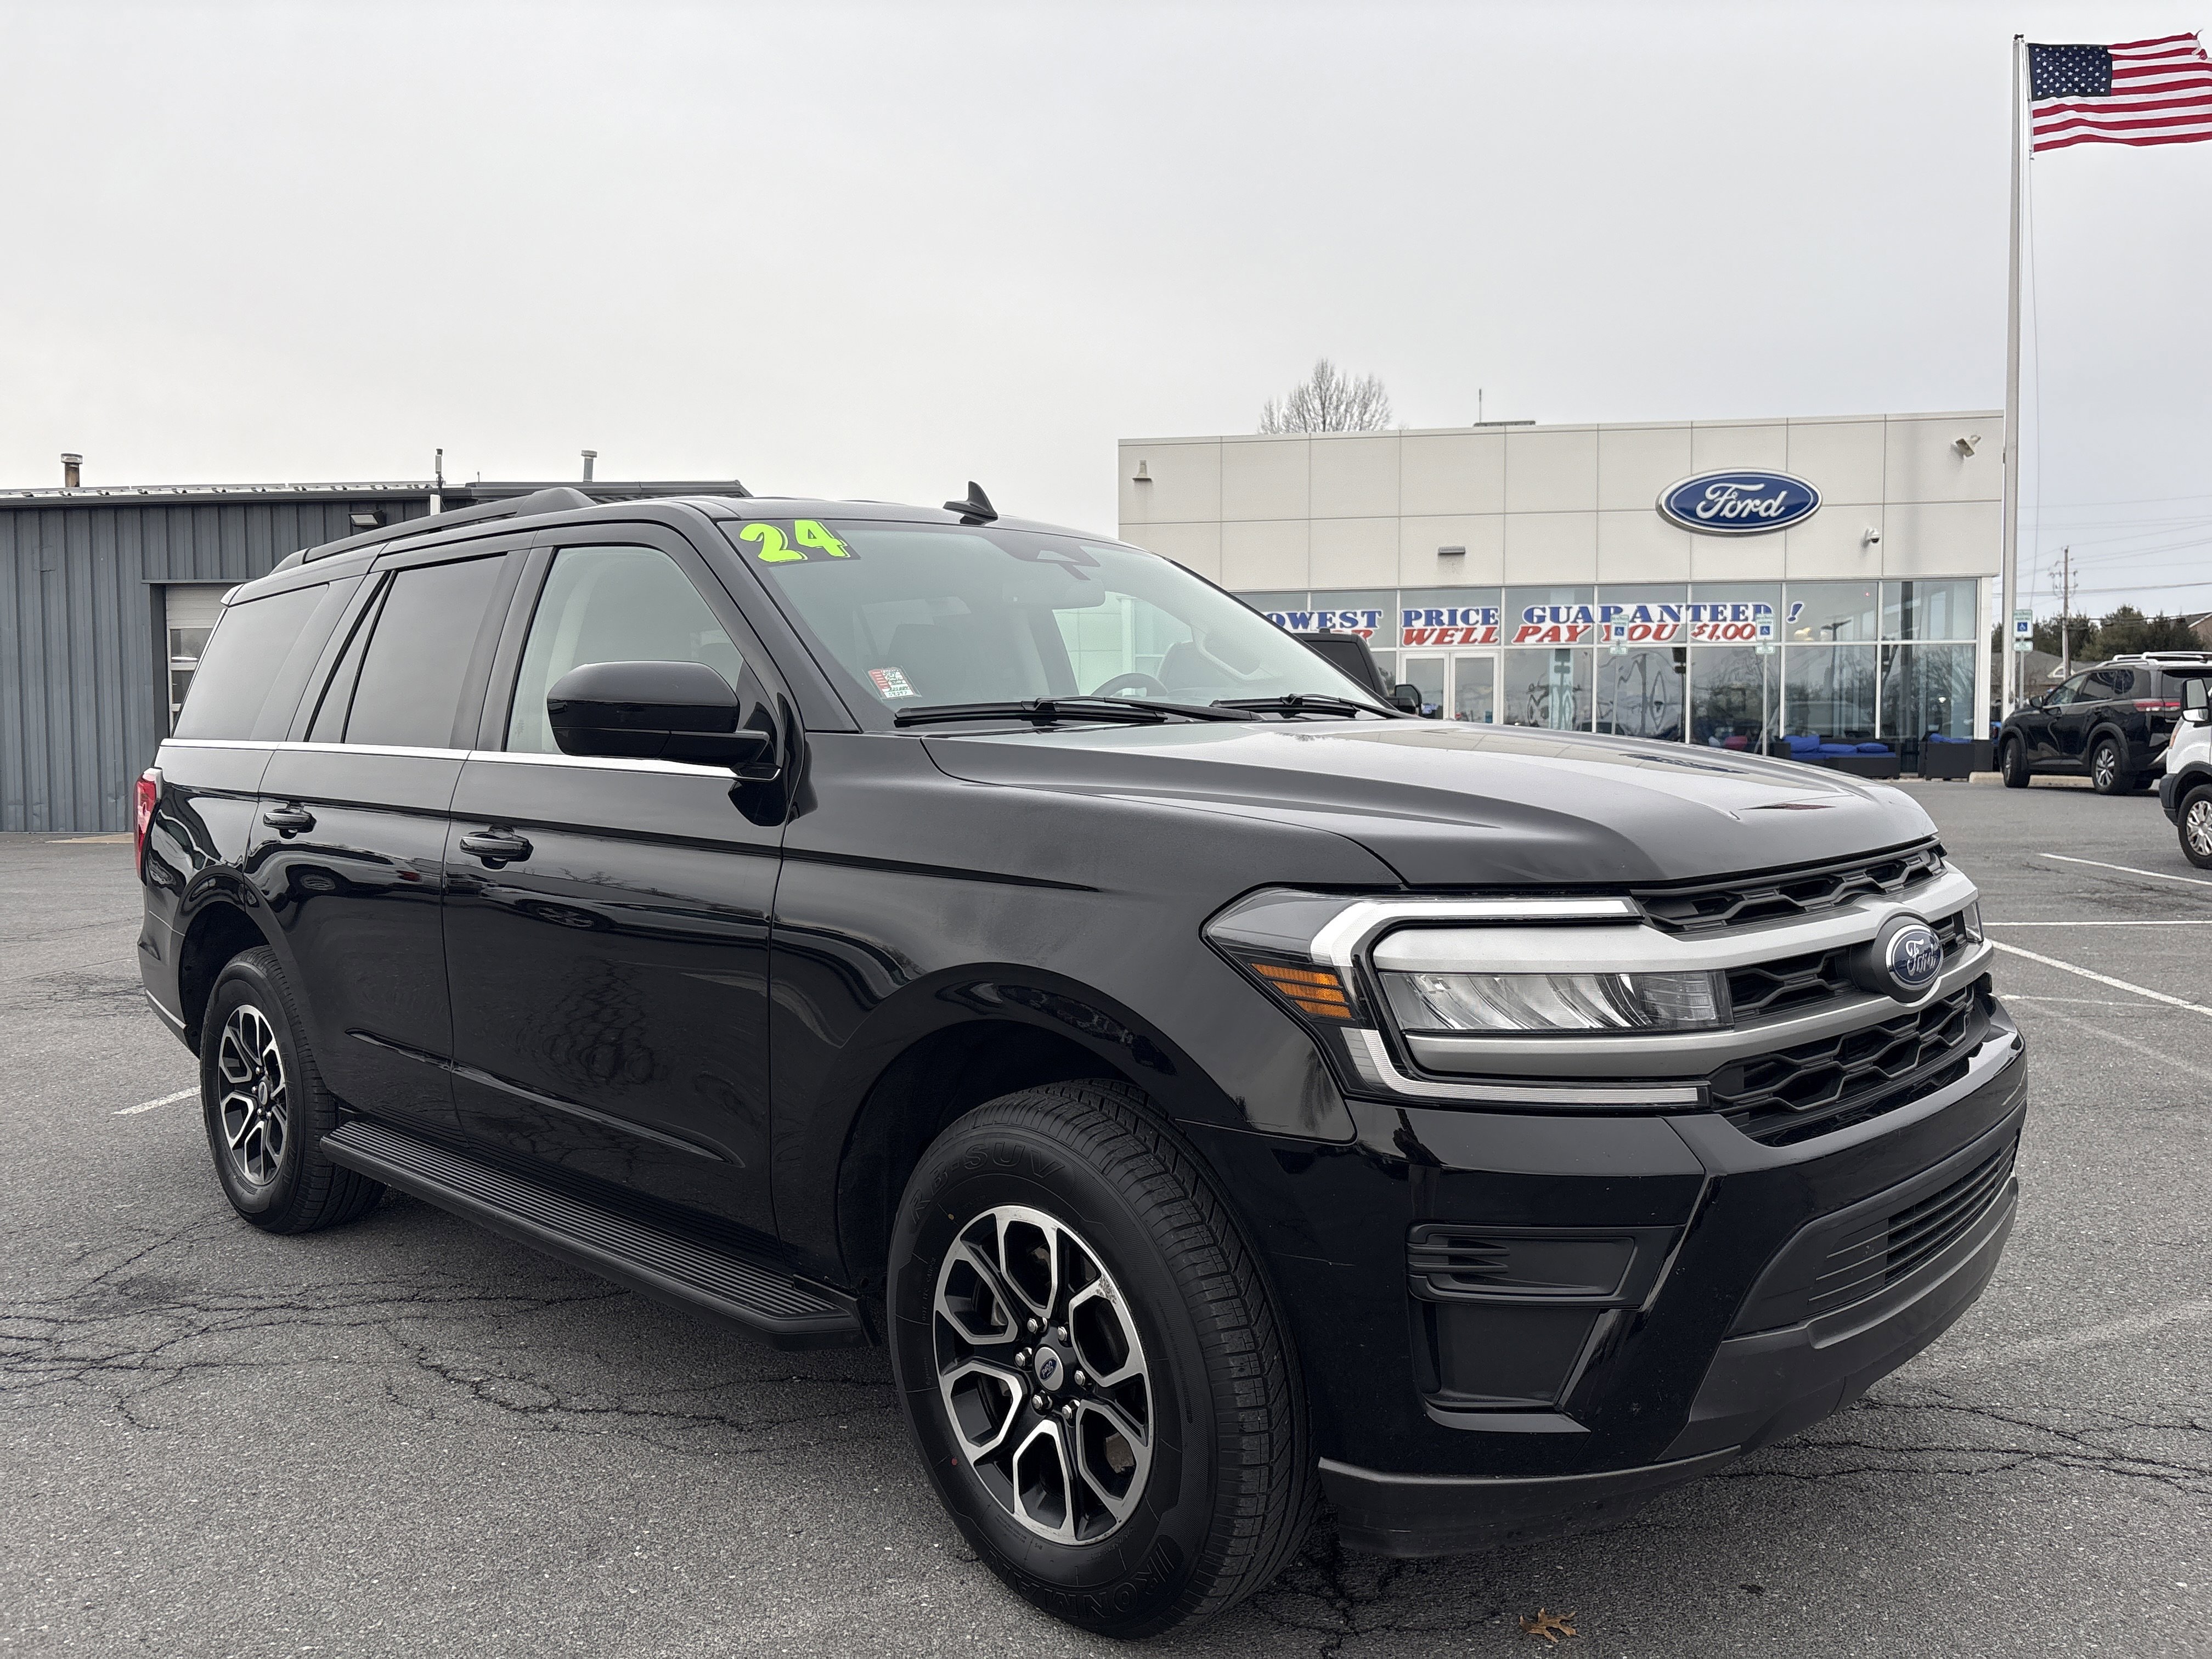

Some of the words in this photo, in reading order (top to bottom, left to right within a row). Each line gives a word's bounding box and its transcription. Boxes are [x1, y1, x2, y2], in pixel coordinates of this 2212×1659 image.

[1696, 483, 1787, 519] Ford
[740, 520, 850, 563] 24
[1267, 611, 1382, 629] OWEST
[1402, 607, 1499, 628] PRICE
[1513, 625, 1590, 644] PAY
[1905, 939, 1937, 976] Ford
